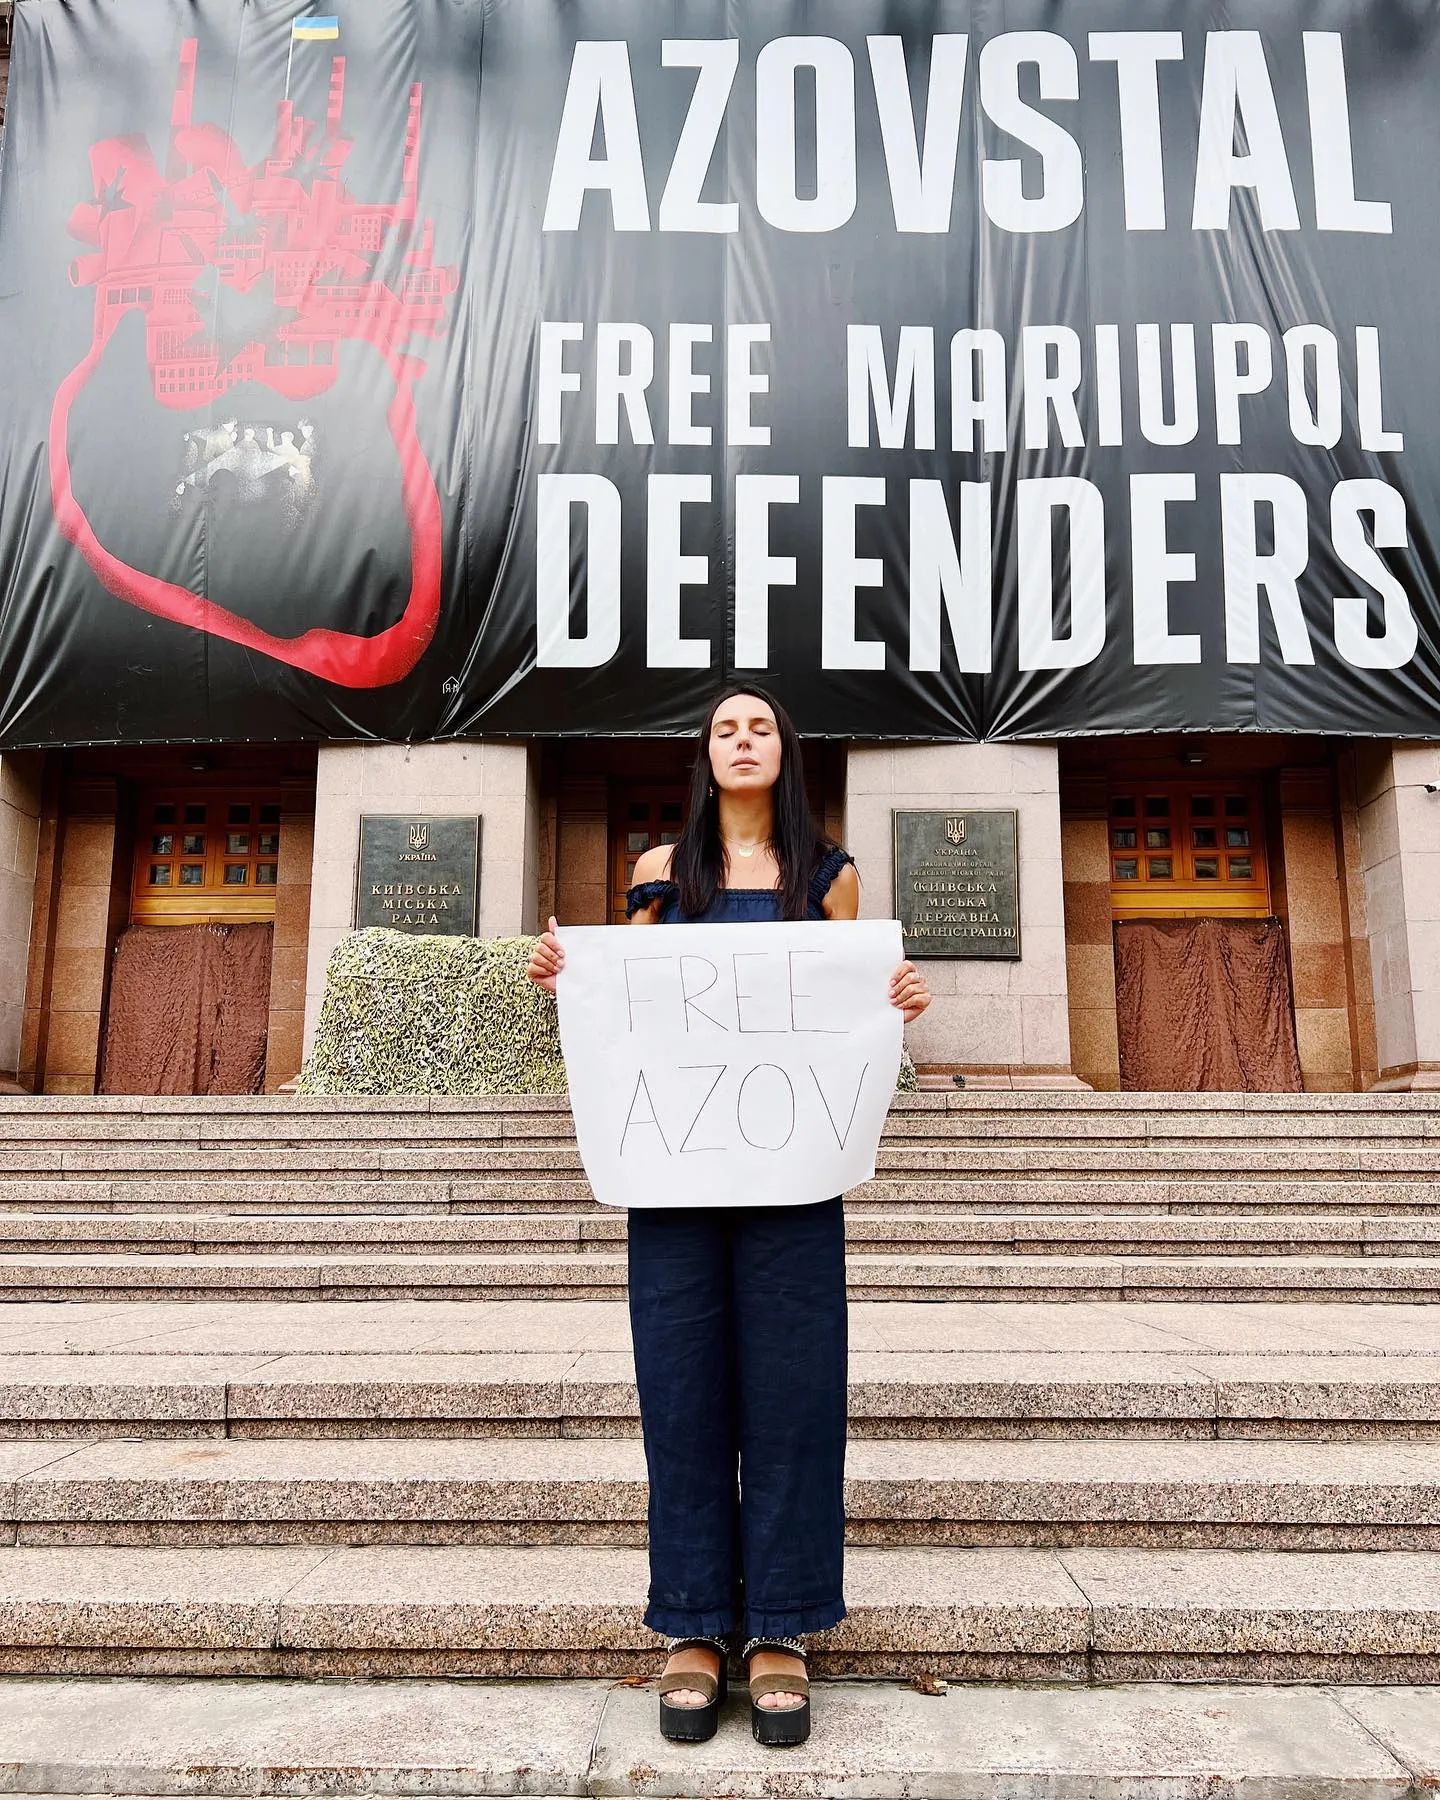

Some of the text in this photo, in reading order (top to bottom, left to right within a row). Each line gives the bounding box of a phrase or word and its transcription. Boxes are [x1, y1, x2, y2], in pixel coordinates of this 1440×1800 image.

[541, 31, 1394, 234] AZOVSTAL
[537, 321, 1403, 452] FREE MARIUPOL
[536, 473, 1418, 672] DEFENDERS
[399, 852, 437, 861] УКРАЇНА
[371, 883, 462, 895] КИЇВСЬКА
[913, 882, 997, 894] (КИЇВСЬКА
[382, 899, 449, 910] МІСЬКА
[926, 897, 987, 908] МІСЬКА
[391, 913, 441, 925] РАДА
[914, 912, 1000, 923] ДЕРЖАВНА
[623, 950, 849, 1033] FREE
[619, 1062, 869, 1156] AZOV
